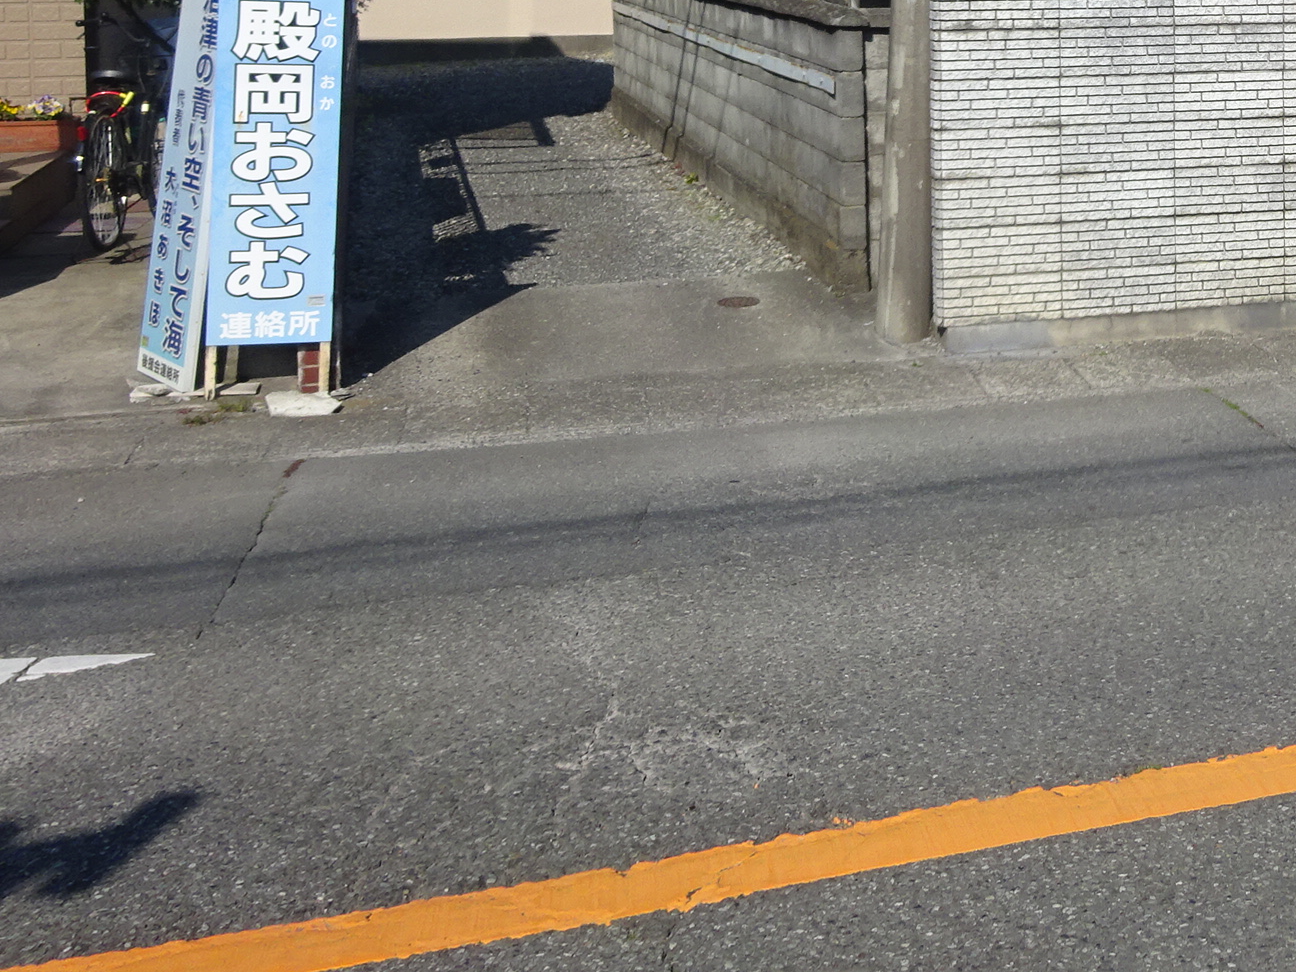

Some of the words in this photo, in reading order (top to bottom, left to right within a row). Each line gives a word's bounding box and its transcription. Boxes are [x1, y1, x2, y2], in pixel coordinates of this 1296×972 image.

[321, 12, 338, 50] との
[319, 74, 336, 111] おか
[225, 0, 321, 300] 殿岡おさむ
[148, 166, 177, 328] 大沼あきほ
[219, 310, 321, 340] 連絡所
[141, 353, 180, 384] 後援会連絡所
